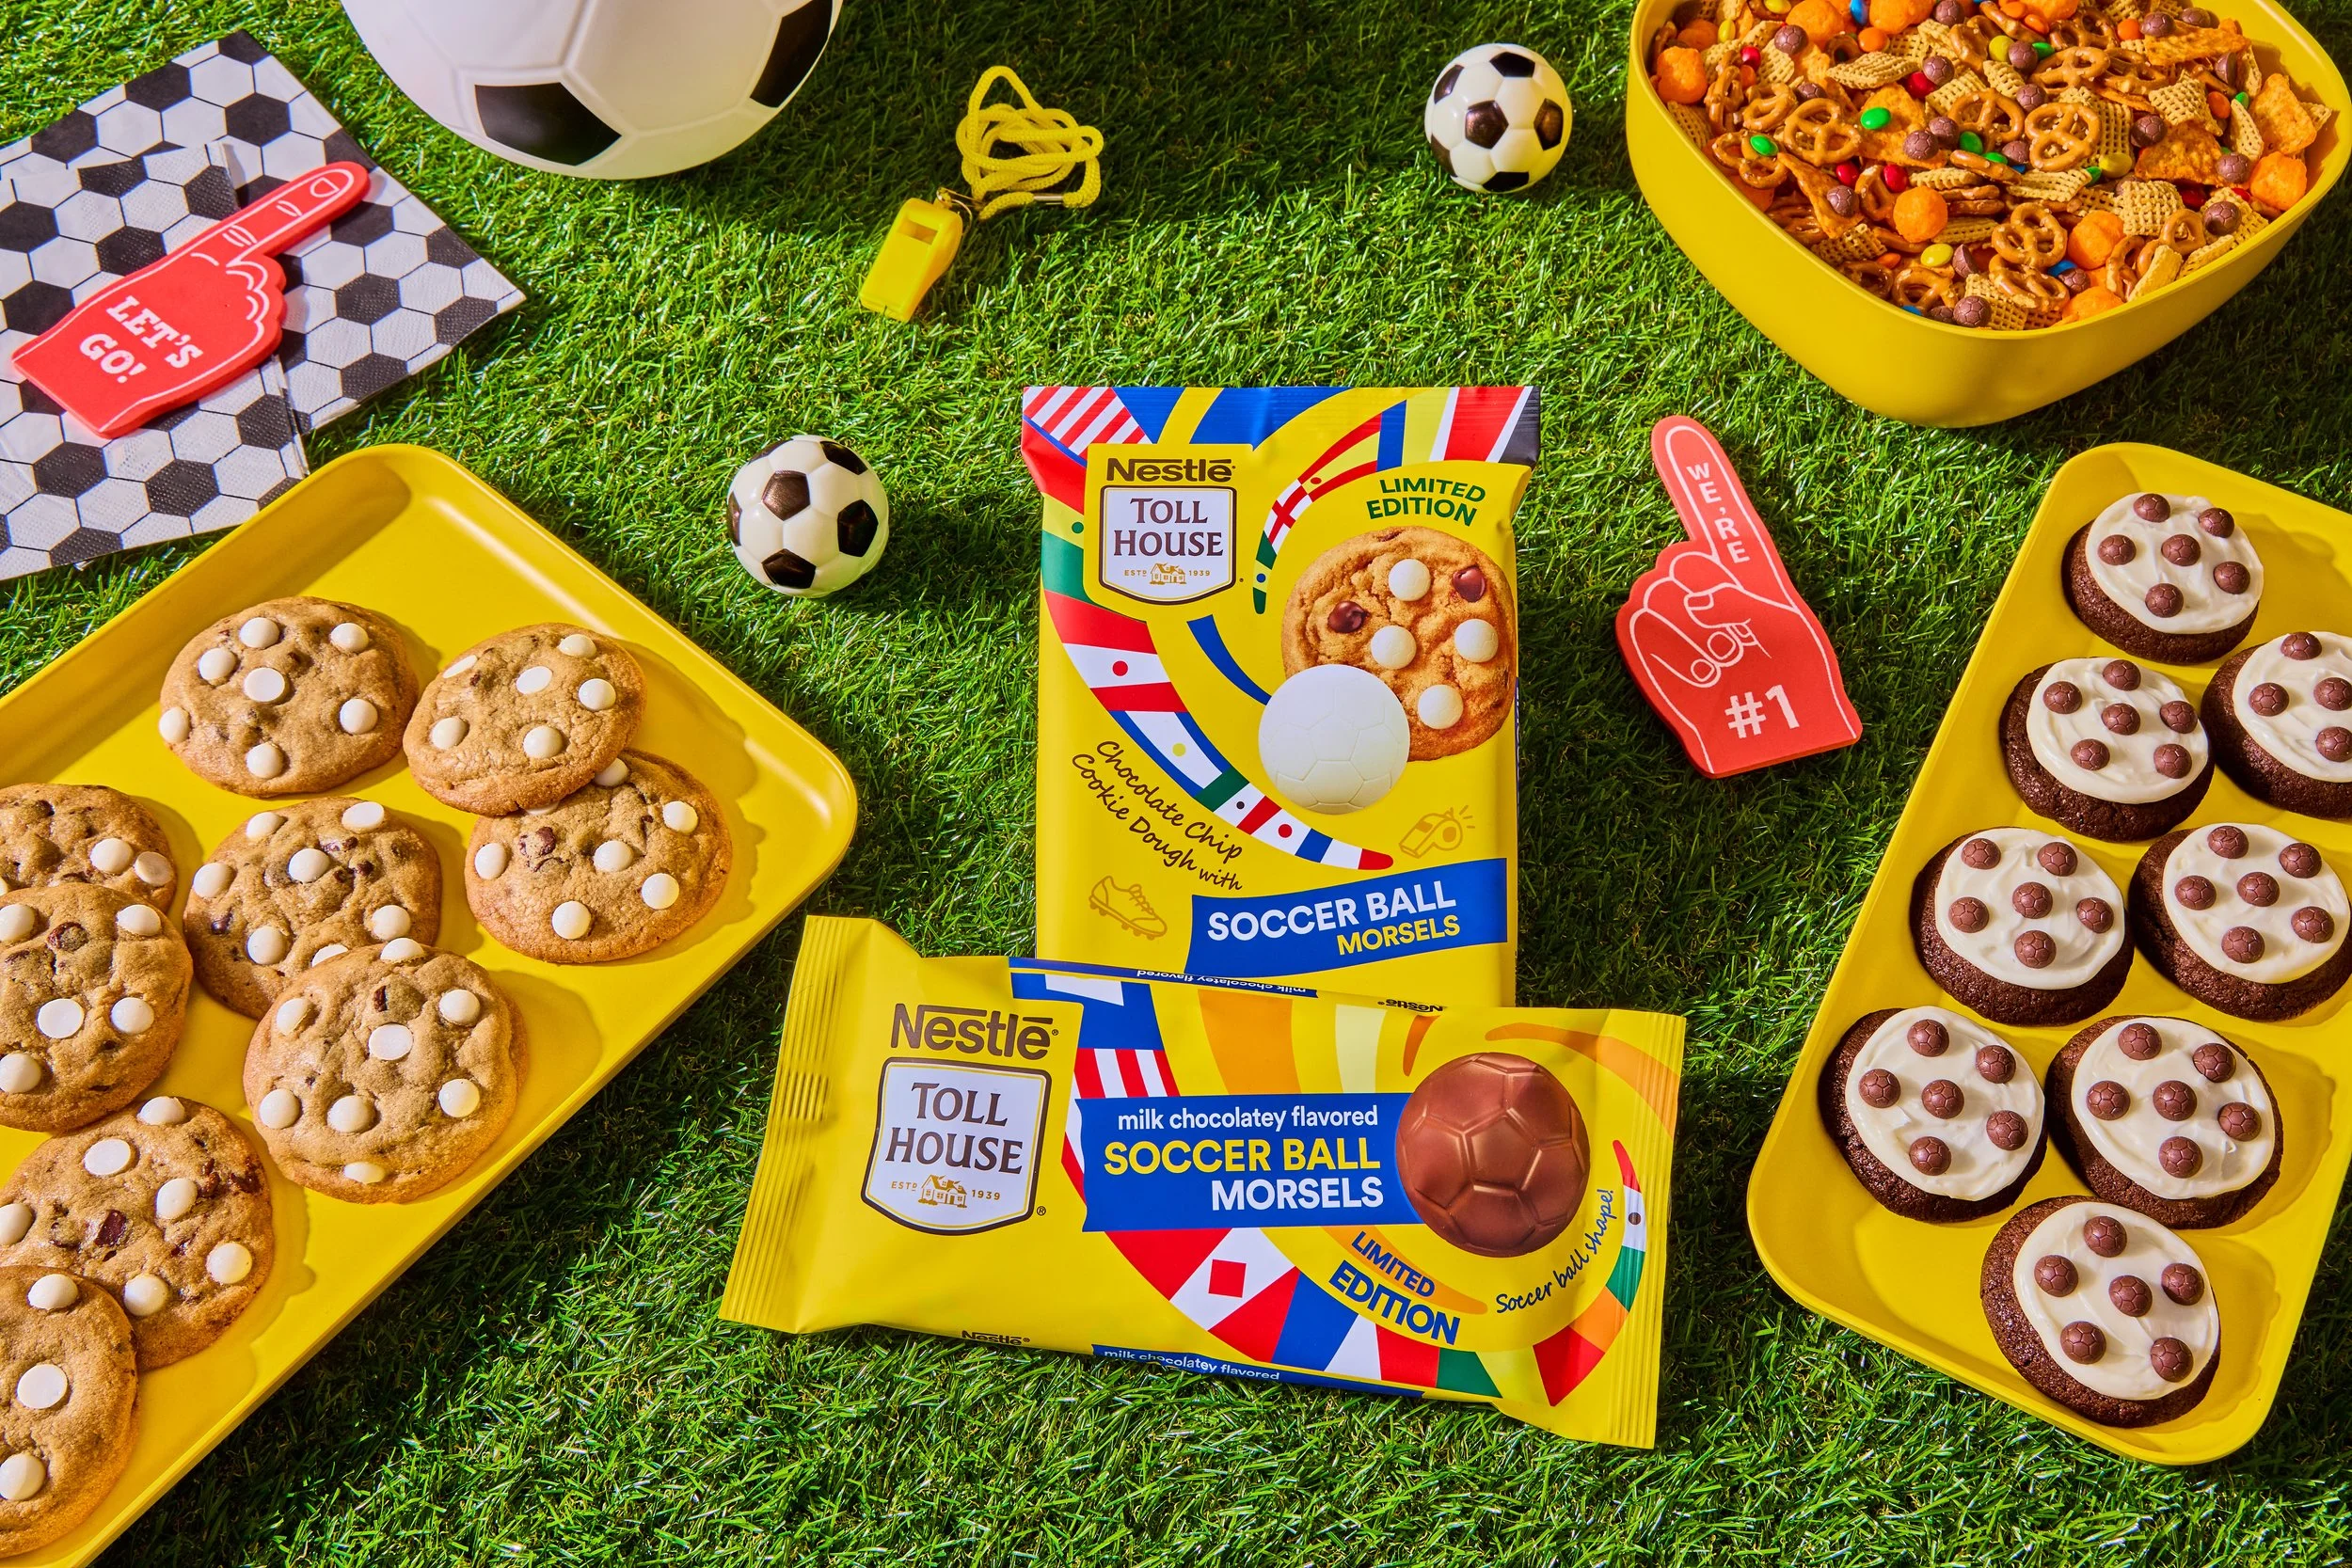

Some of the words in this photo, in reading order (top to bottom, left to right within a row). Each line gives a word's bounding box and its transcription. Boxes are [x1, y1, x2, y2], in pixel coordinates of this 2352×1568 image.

[105, 294, 204, 369] LET'S
[79, 333, 147, 384] GO!
[1129, 498, 1209, 524] TOLL
[1378, 477, 1486, 503] LIMITED
[1365, 497, 1478, 528] EDITION
[1685, 461, 1751, 564] WE'RE
[1113, 530, 1224, 557] HOUSE
[1724, 683, 1800, 739] #1
[1072, 753, 1130, 820] Cookie
[1128, 816, 1198, 871] Dough
[1199, 868, 1243, 891] with
[1096, 740, 1184, 827] Chocolate
[1184, 821, 1243, 865] Chip
[1206, 896, 1359, 942] SOCCER
[1365, 879, 1457, 922] BALL
[1335, 913, 1461, 956] MORSELS
[1136, 969, 1193, 983] flavored
[1196, 974, 1274, 991] chocolatey
[1276, 984, 1307, 994] milk
[910, 1082, 1009, 1127] TOLL
[1117, 1108, 1165, 1131] milk
[1168, 1105, 1287, 1132] chocolatey
[1291, 1104, 1379, 1128] flavored
[884, 1126, 1025, 1175] HOUSE
[1104, 1138, 1272, 1176] SOCCER
[1283, 1136, 1381, 1172] BALL
[971, 1188, 1001, 1201] 1939
[1211, 1176, 1384, 1212] MORSELS
[1351, 1230, 1436, 1297] LIMITED
[1495, 1281, 1553, 1314] Soccer
[1552, 1248, 1590, 1289] ball
[1583, 1188, 1617, 1256] shape!
[1327, 1259, 1461, 1346] EDITION
[1103, 1349, 1136, 1360] milk
[1138, 1353, 1218, 1374] chocolatey
[1220, 1363, 1280, 1381] flavored
